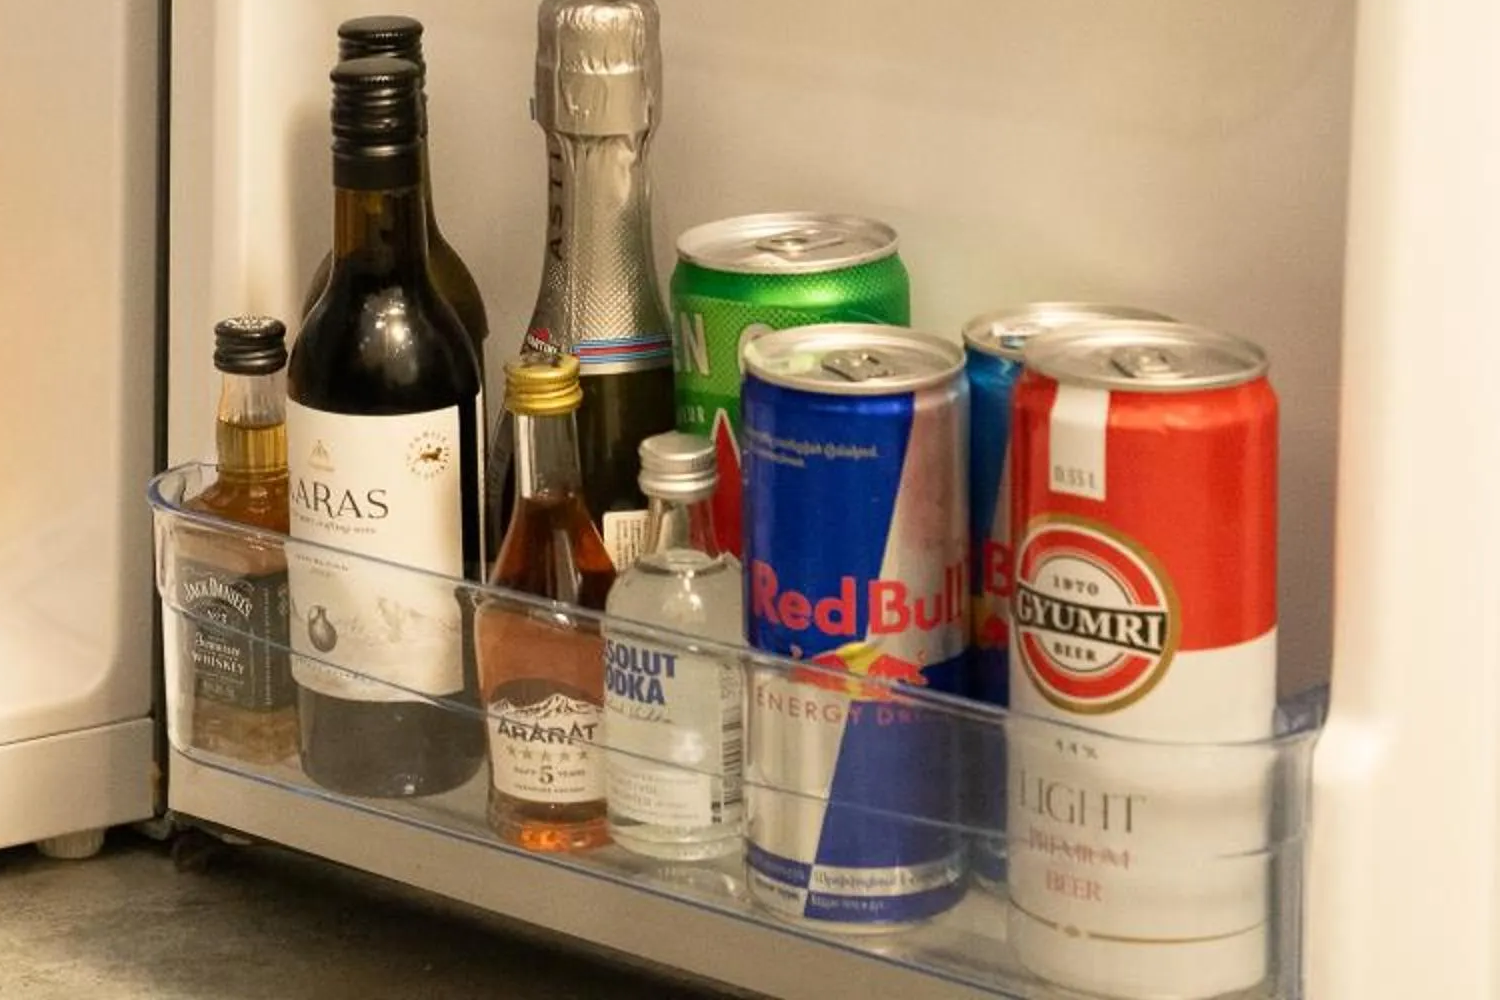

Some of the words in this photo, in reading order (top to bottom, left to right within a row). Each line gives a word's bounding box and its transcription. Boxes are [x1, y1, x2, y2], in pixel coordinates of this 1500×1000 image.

[290, 476, 390, 520] ARAS
[752, 559, 856, 636] Red
[868, 565, 963, 634] Bull
[1052, 574, 1100, 597] 1970
[1017, 589, 1162, 650] GYUMRI
[606, 638, 678, 679] SOLUT
[1052, 642, 1098, 663] BEER
[606, 663, 667, 706] ODKA
[756, 684, 863, 726] ENERGY
[497, 715, 599, 746] ARARAT
[538, 763, 555, 785] 5
[1019, 766, 1149, 835] LIGHT
[1045, 868, 1104, 902] BEER
